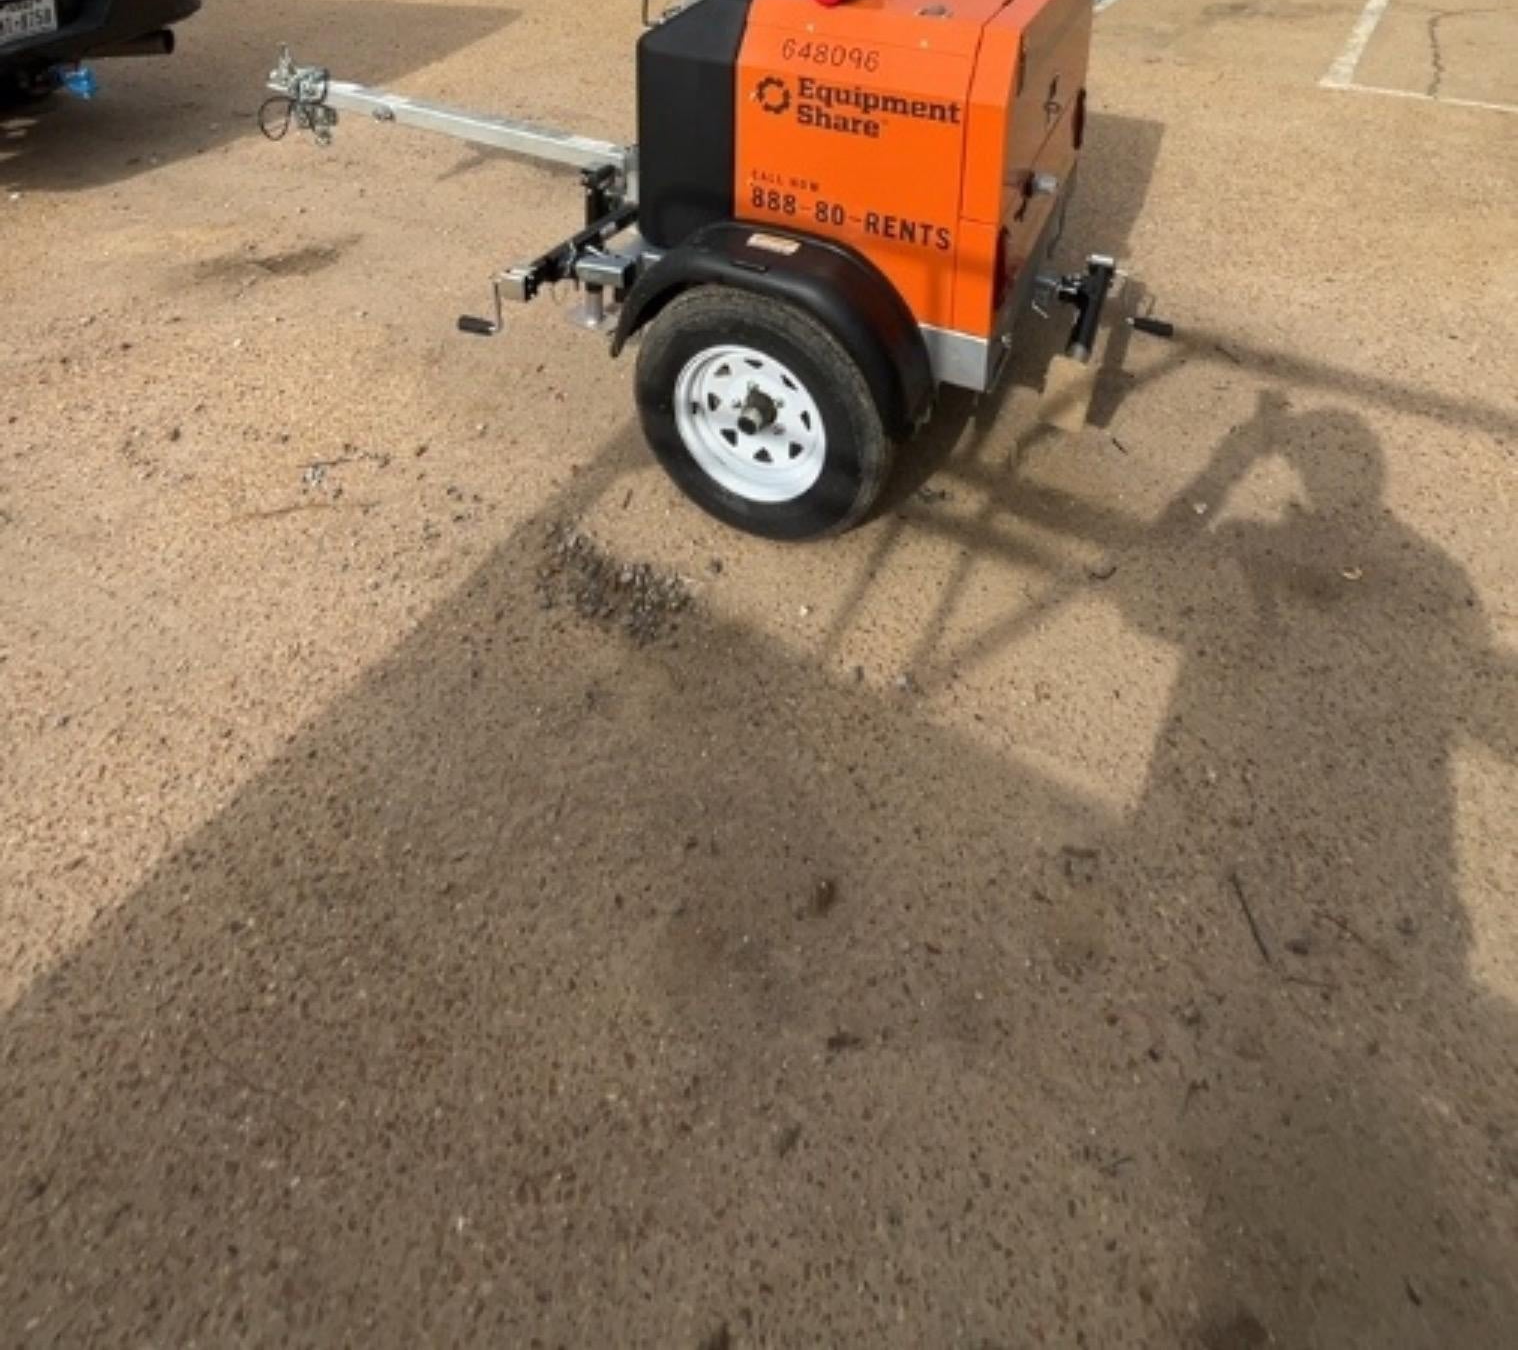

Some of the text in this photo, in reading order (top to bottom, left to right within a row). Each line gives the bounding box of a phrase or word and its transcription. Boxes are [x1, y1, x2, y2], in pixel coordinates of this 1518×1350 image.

[782, 38, 881, 73] 648096
[797, 76, 961, 125] Equipment
[797, 104, 880, 139] Share
[751, 186, 951, 251] 888-80-RENTS
